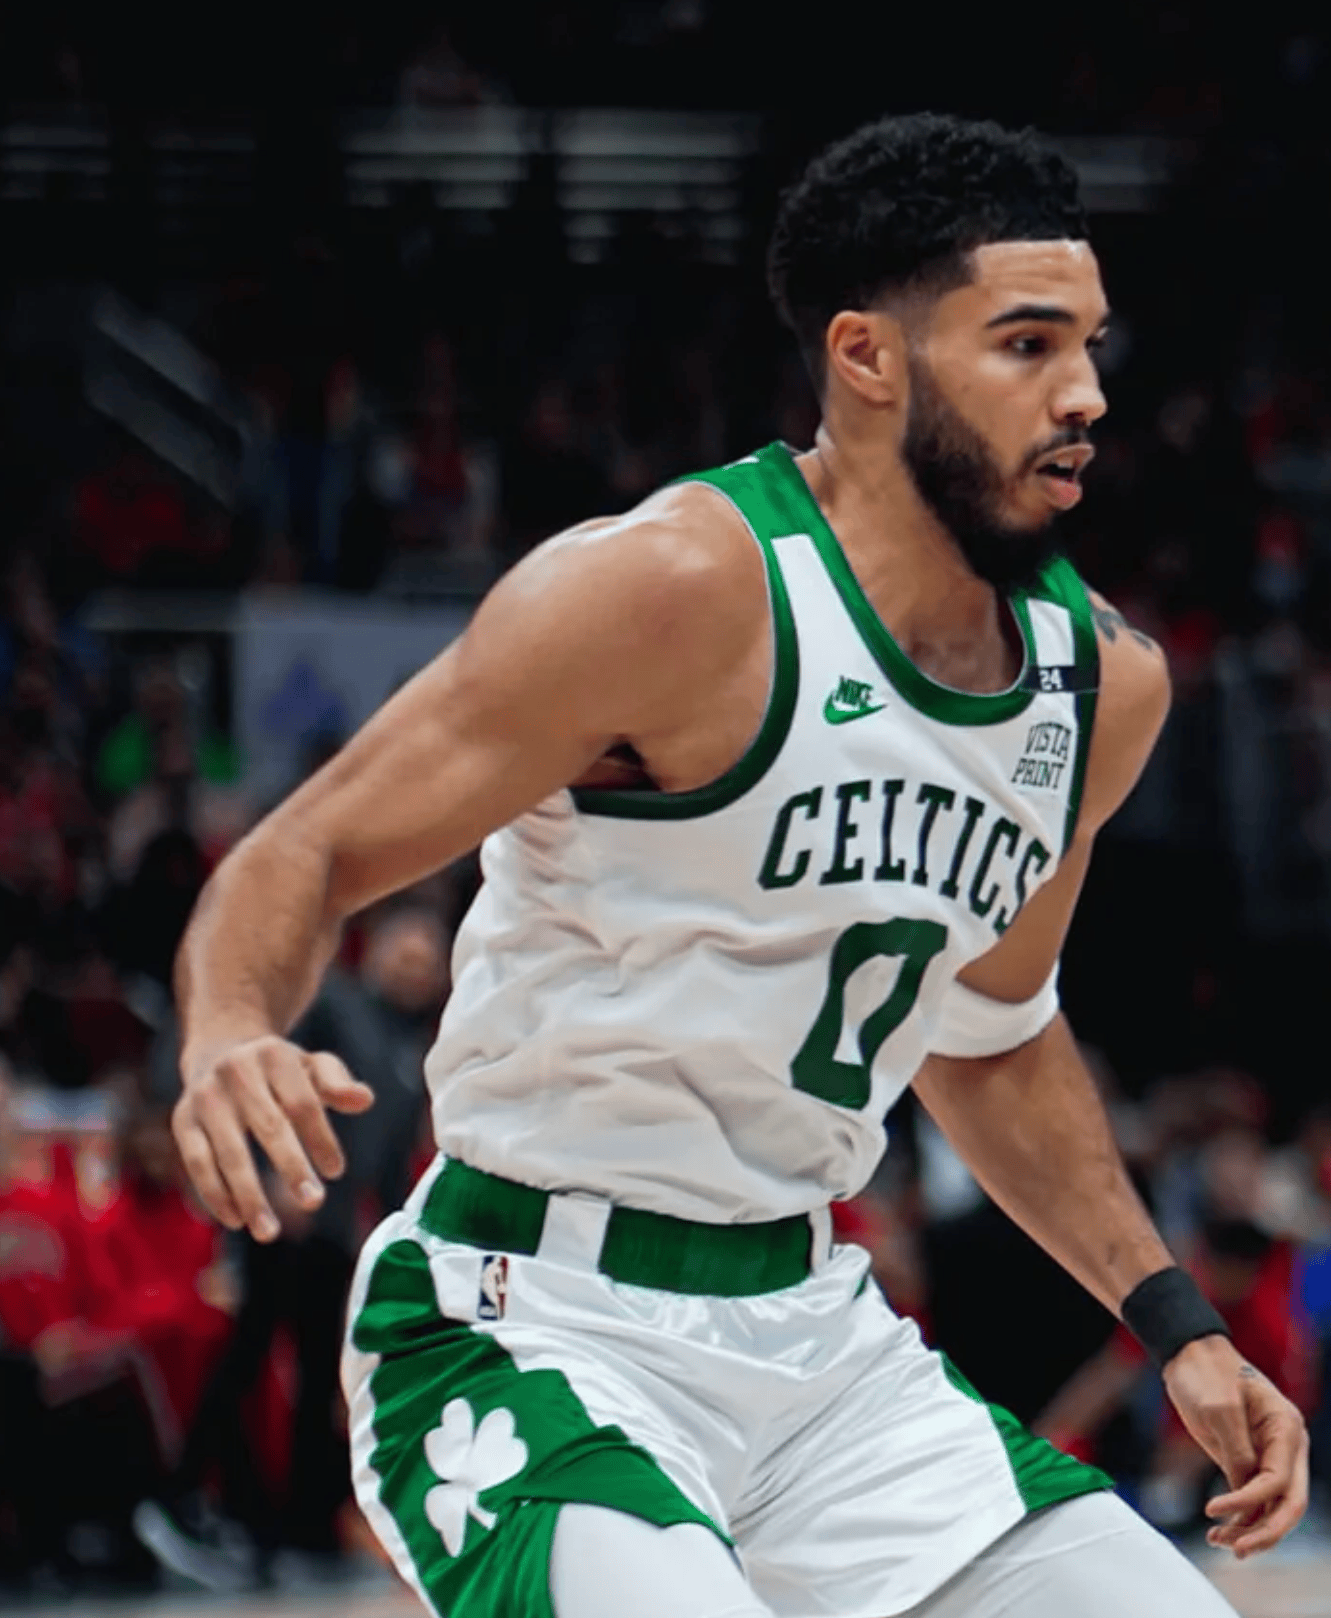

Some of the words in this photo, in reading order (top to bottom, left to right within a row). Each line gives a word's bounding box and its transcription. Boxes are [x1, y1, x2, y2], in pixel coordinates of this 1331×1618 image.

[834, 675, 874, 708] NIKE
[1039, 667, 1063, 691] 24
[1025, 721, 1072, 761] VISTA
[1010, 758, 1065, 789] PRINT
[758, 780, 1050, 934] CELTICS
[791, 917, 948, 1111] 0
